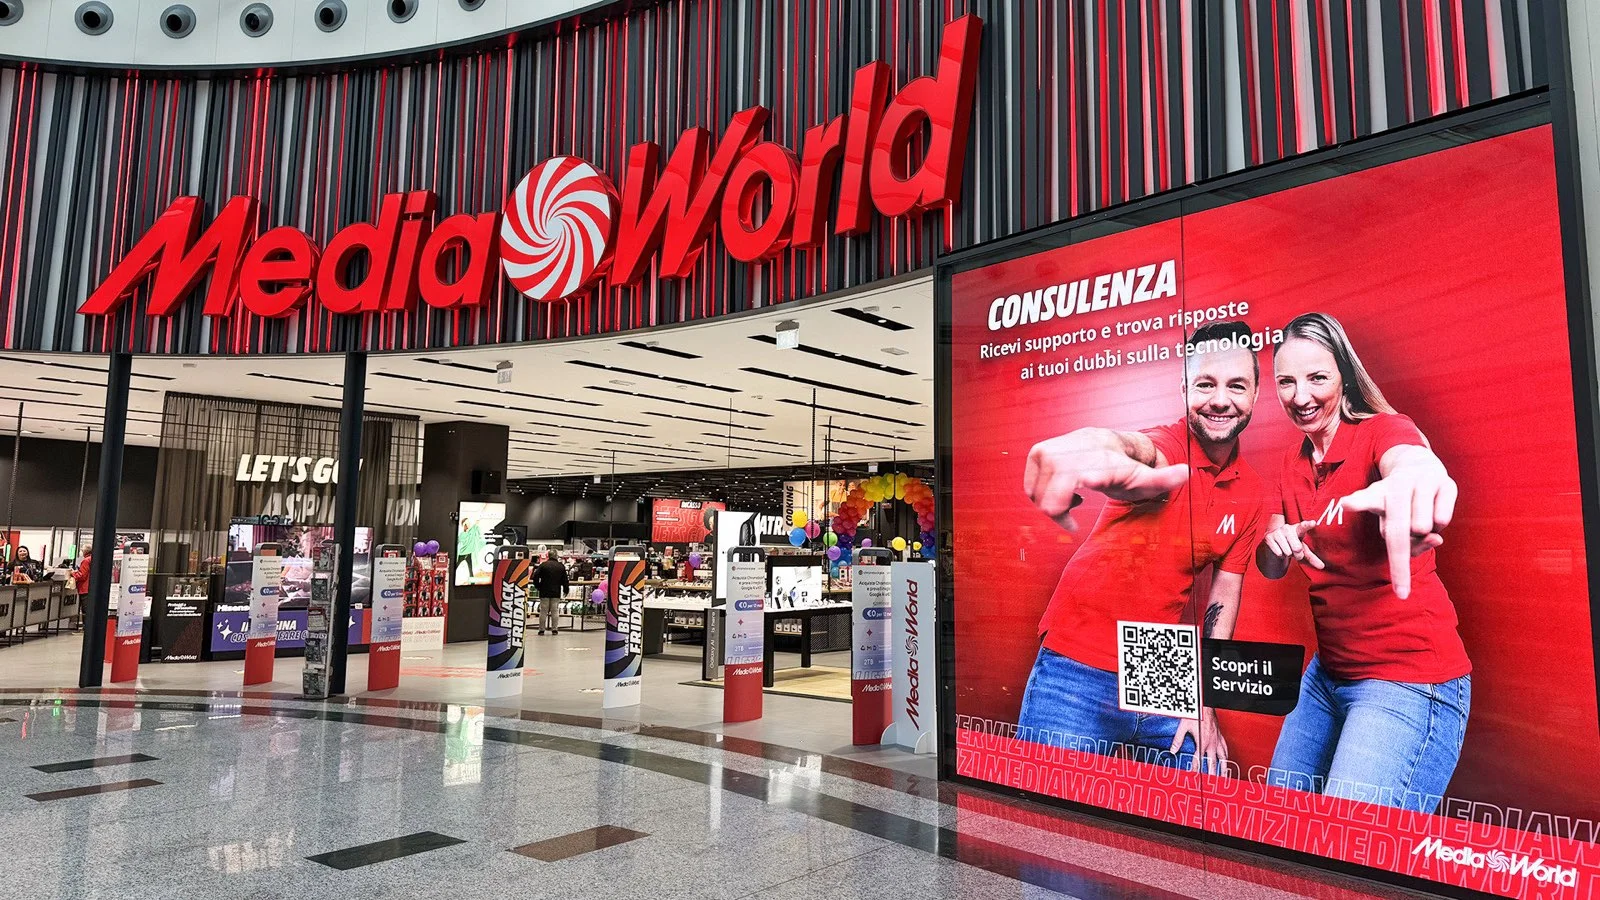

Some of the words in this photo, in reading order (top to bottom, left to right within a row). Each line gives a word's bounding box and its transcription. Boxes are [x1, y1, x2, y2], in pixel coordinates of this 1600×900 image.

[987, 259, 1177, 331] CONSULENZA
[980, 339, 1021, 359] Ricevi
[1025, 329, 1097, 352] supporto
[1101, 326, 1112, 340] e
[1116, 317, 1163, 336] trova
[1169, 301, 1250, 330] risposte
[1020, 363, 1034, 380] ai
[1037, 358, 1069, 377] tuoi
[1073, 350, 1122, 372] dubbi
[1127, 343, 1170, 364] sulla
[1175, 326, 1285, 358] tecnologia
[235, 454, 313, 484] LET'S
[785, 485, 794, 527] COOKING
[1216, 514, 1234, 534] M
[1316, 498, 1344, 526] M
[500, 580, 514, 628] BLACK
[512, 585, 526, 649] FRIDAY
[617, 582, 632, 633] BLACK
[629, 587, 643, 655] FRIDAY
[905, 579, 919, 637] World
[1212, 656, 1258, 677] Scopri
[1263, 660, 1273, 676] il
[1212, 676, 1273, 696] Servizio
[905, 657, 920, 731] Media
[956, 713, 1034, 758] ERVIZI
[1035, 728, 1241, 798] MEDIAWORLD
[1245, 765, 1395, 828] SERVIZI
[1411, 836, 1485, 869] Media
[1509, 853, 1577, 888] World
